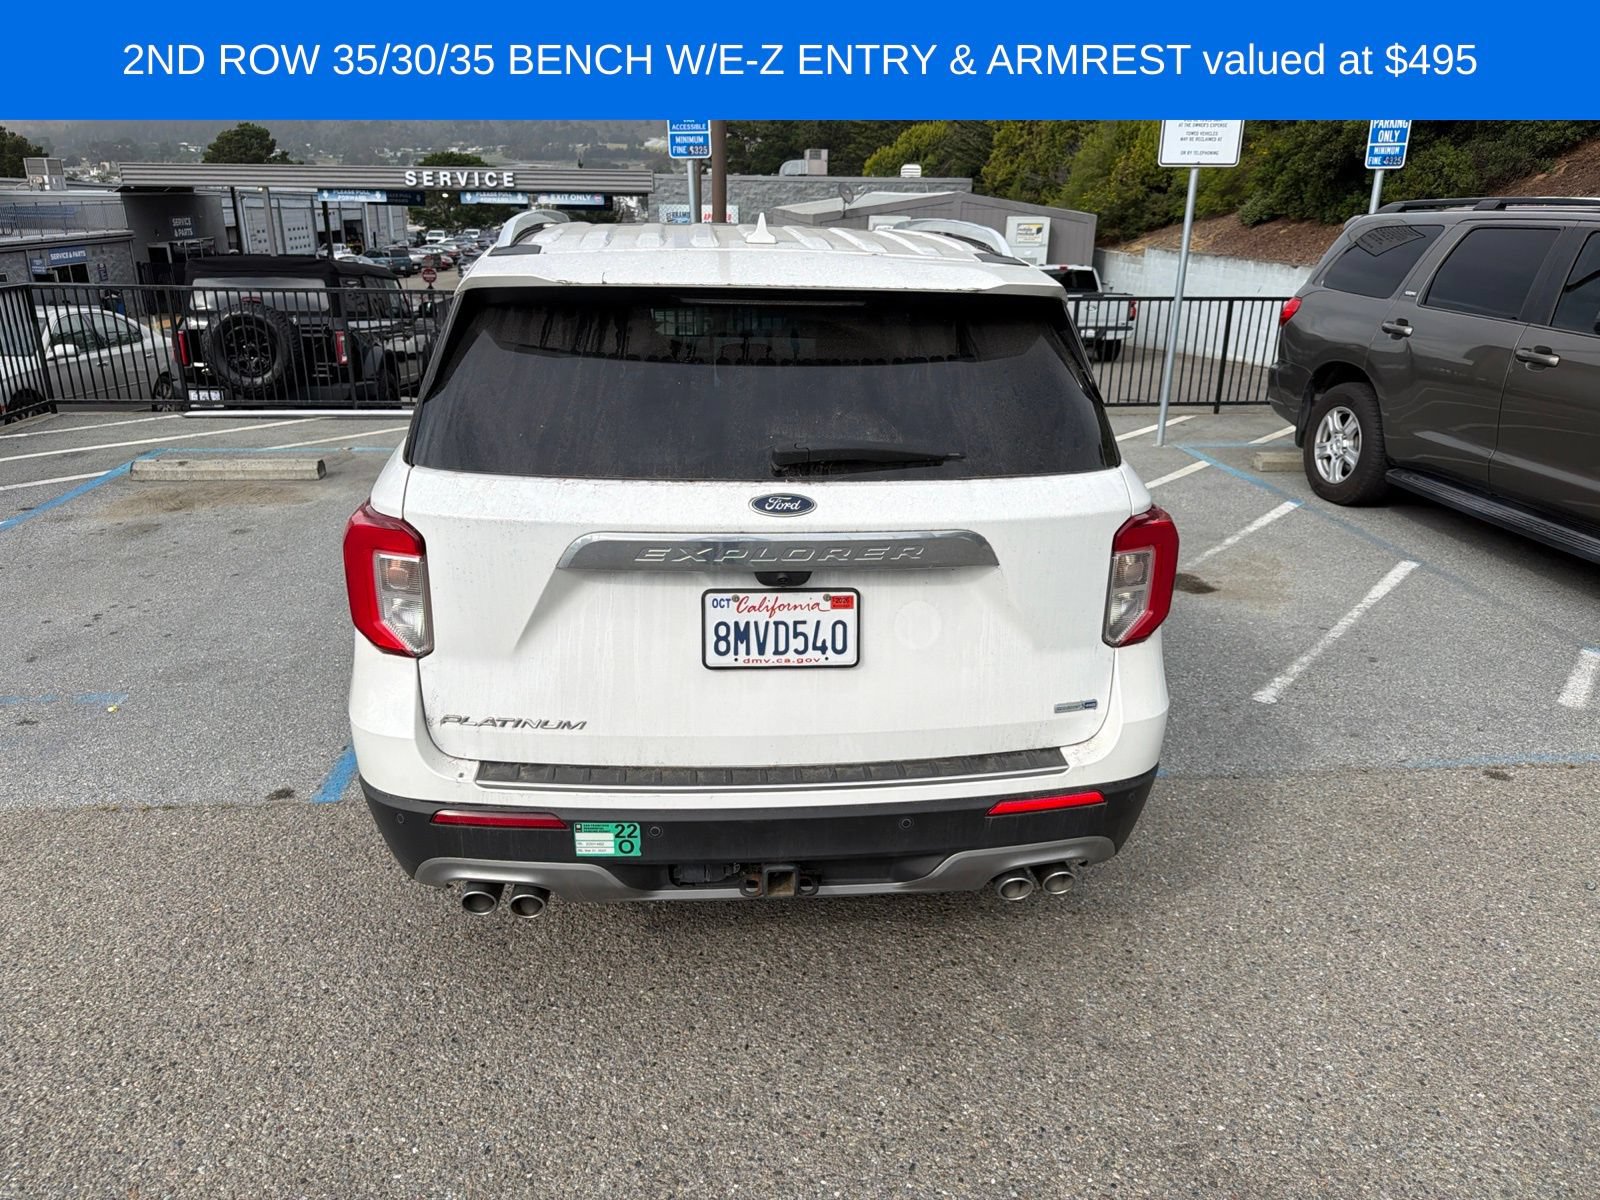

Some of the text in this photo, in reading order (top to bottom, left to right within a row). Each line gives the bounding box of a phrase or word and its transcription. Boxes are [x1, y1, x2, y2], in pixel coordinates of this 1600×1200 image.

[1373, 120, 1409, 129] PARKING
[675, 136, 704, 144] MINIMUM
[1377, 129, 1401, 143] ONLY
[672, 146, 687, 154] FINE
[1373, 146, 1401, 155] MINIMUM
[1368, 156, 1382, 165] FINE
[405, 170, 515, 187] SERVICE
[172, 217, 192, 226] SERVICE
[178, 227, 193, 236] PARTS
[50, 252, 69, 260] SERVICE
[73, 250, 86, 258] PARTS
[765, 496, 801, 510] Ford
[633, 546, 925, 562] EXPLORER
[711, 598, 731, 608] OCT
[736, 595, 831, 618] California
[713, 620, 848, 656] 8MVD540
[743, 657, 821, 665] dmv.ca.gov
[440, 714, 587, 730] PLATINUM
[614, 823, 638, 839] 22
